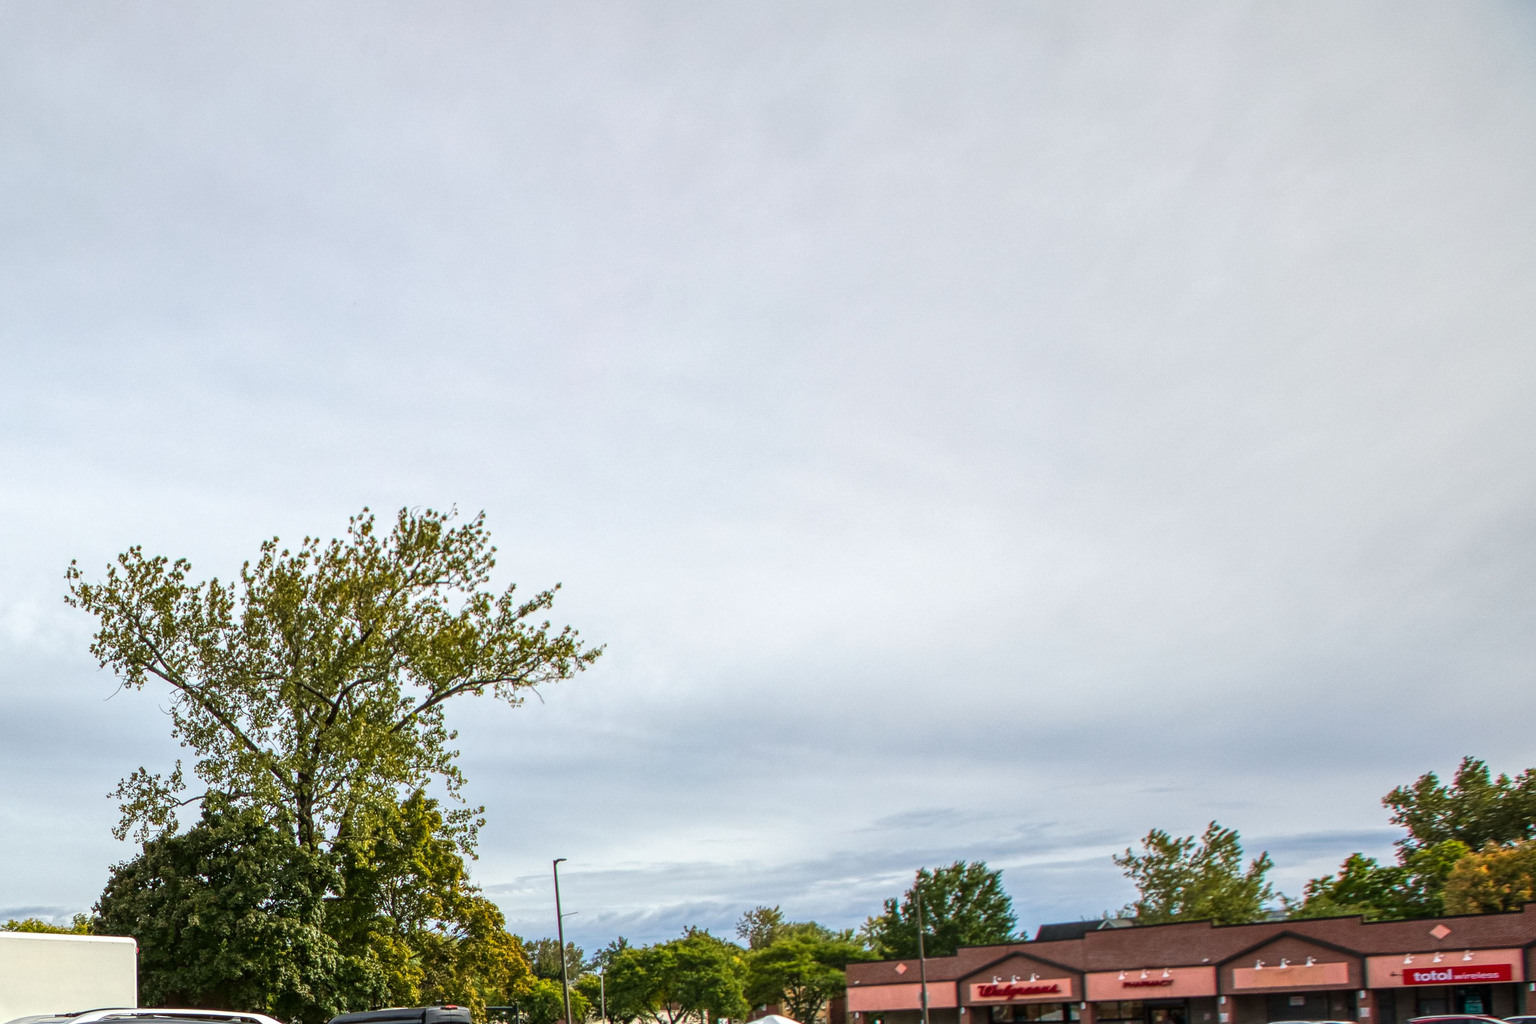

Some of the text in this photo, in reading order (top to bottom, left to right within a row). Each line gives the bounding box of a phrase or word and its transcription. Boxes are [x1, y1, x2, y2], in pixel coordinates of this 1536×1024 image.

[1413, 968, 1500, 982] total wireless
[1122, 979, 1175, 988] PHARMACY
[977, 984, 1061, 1001] Walgreens
